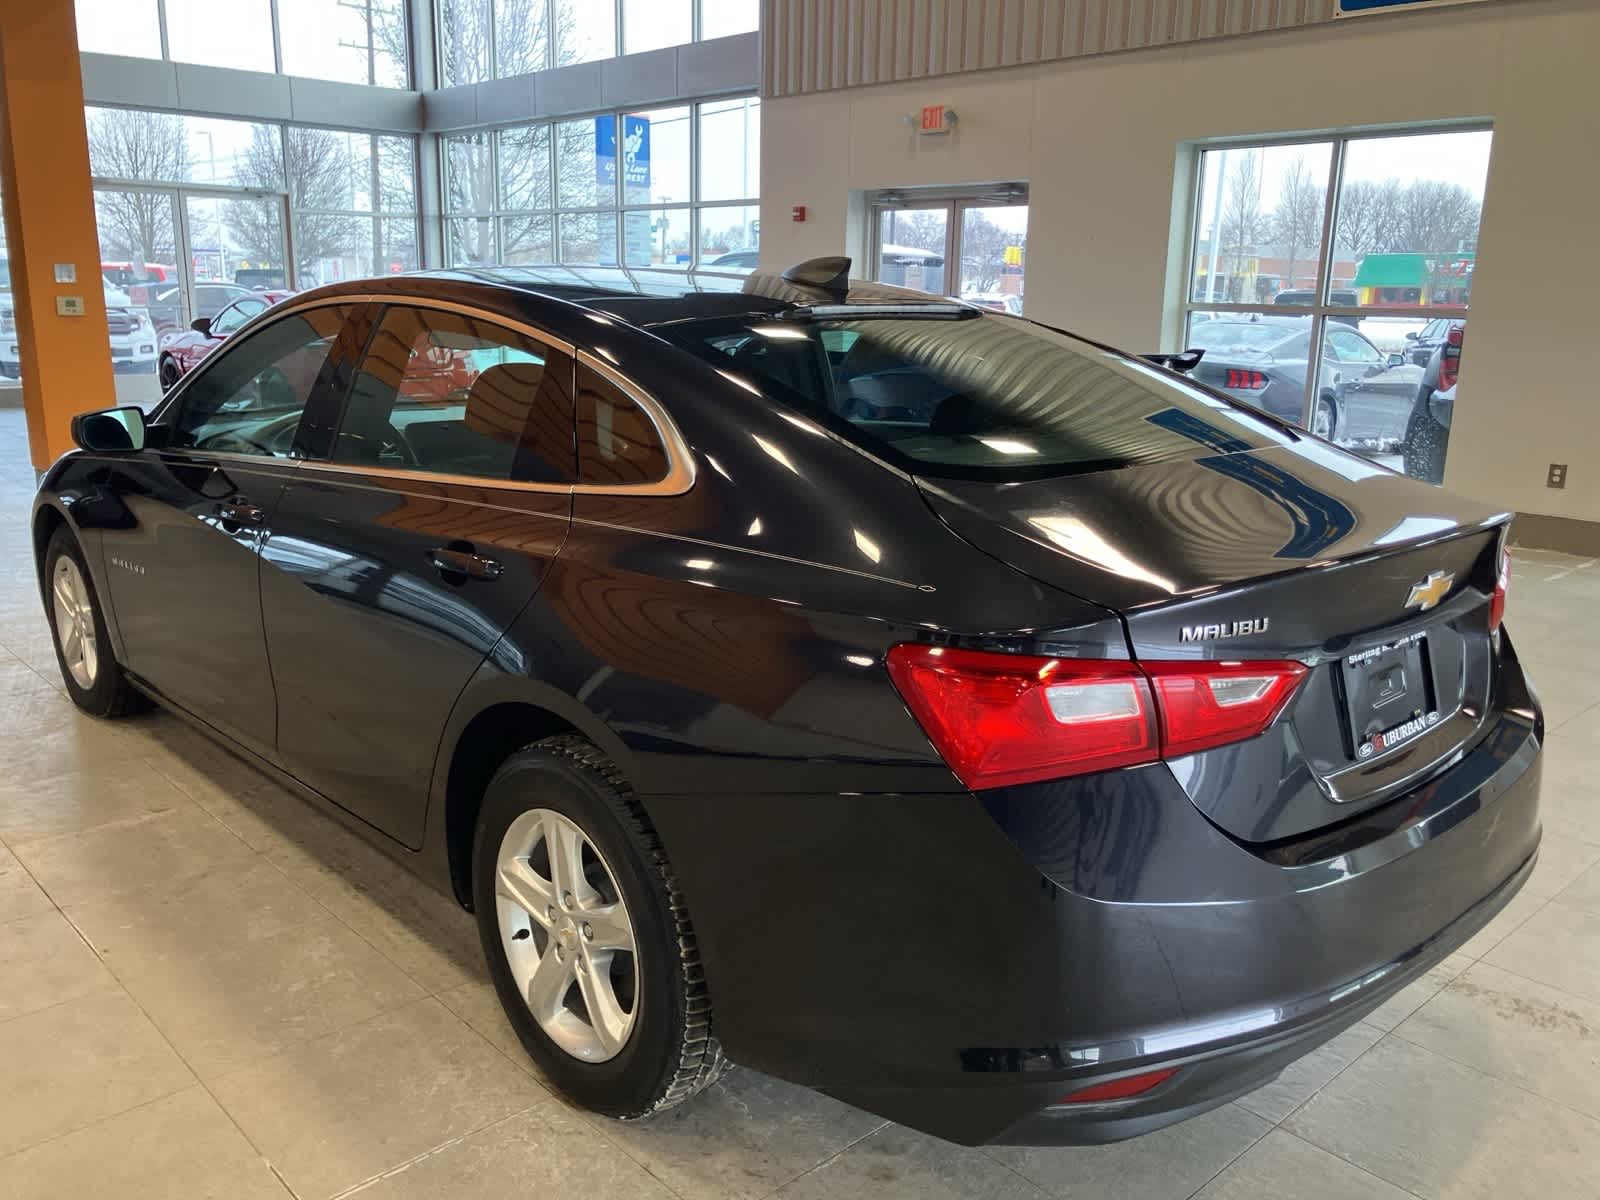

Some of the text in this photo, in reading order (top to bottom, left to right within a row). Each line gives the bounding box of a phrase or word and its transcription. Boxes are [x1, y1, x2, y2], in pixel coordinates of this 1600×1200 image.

[923, 106, 944, 128] EXIT
[1181, 617, 1269, 641] MALIBU
[1348, 647, 1381, 664] Sterling
